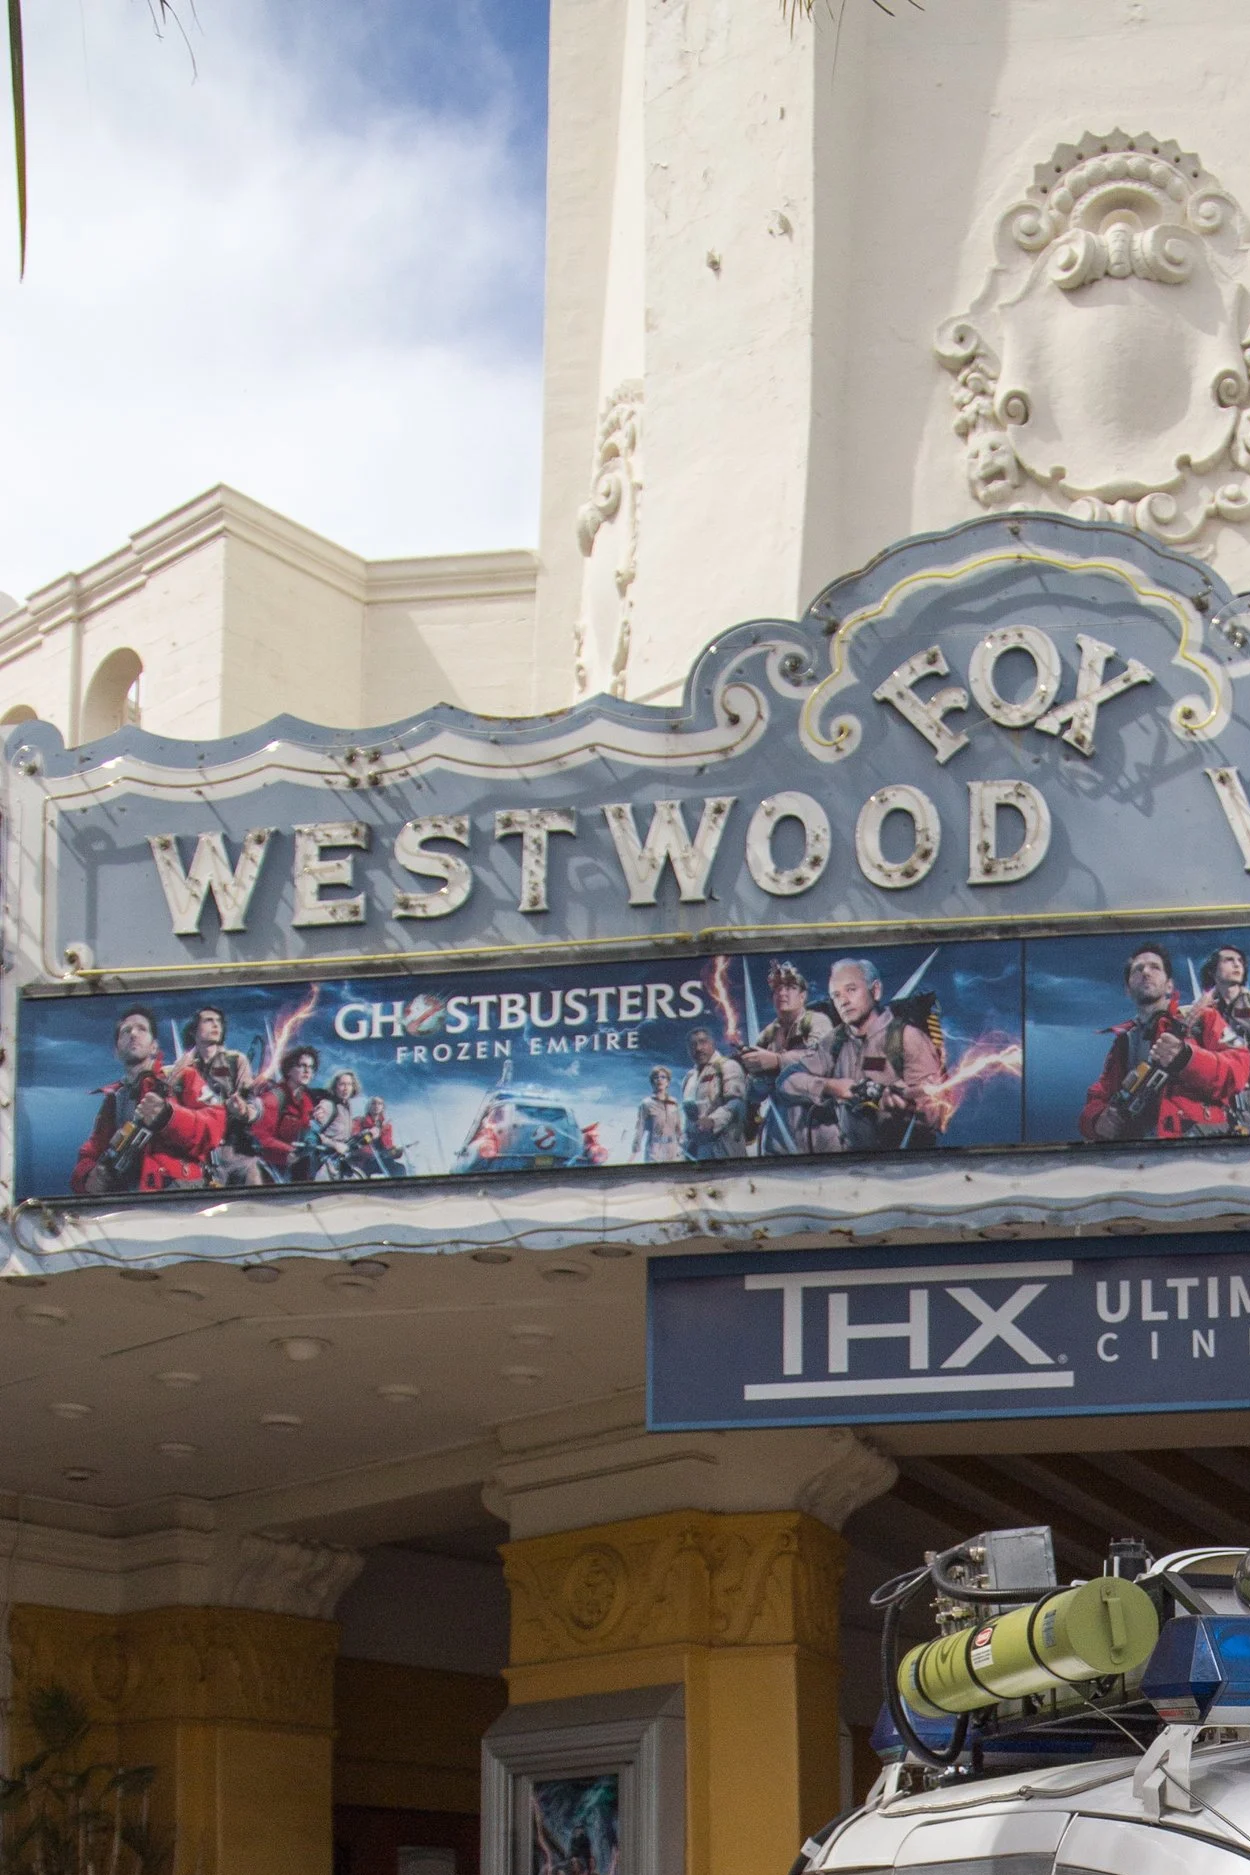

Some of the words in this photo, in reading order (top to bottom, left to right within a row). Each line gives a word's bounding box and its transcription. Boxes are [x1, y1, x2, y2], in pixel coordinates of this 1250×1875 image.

[872, 623, 1154, 766] FOX
[145, 778, 1052, 937] WESTWOOD
[334, 980, 704, 1041] GHOSTBUSTERS
[395, 1040, 512, 1065] FROZEN
[529, 1031, 640, 1057] EMPIRE
[744, 1259, 1074, 1376] THX
